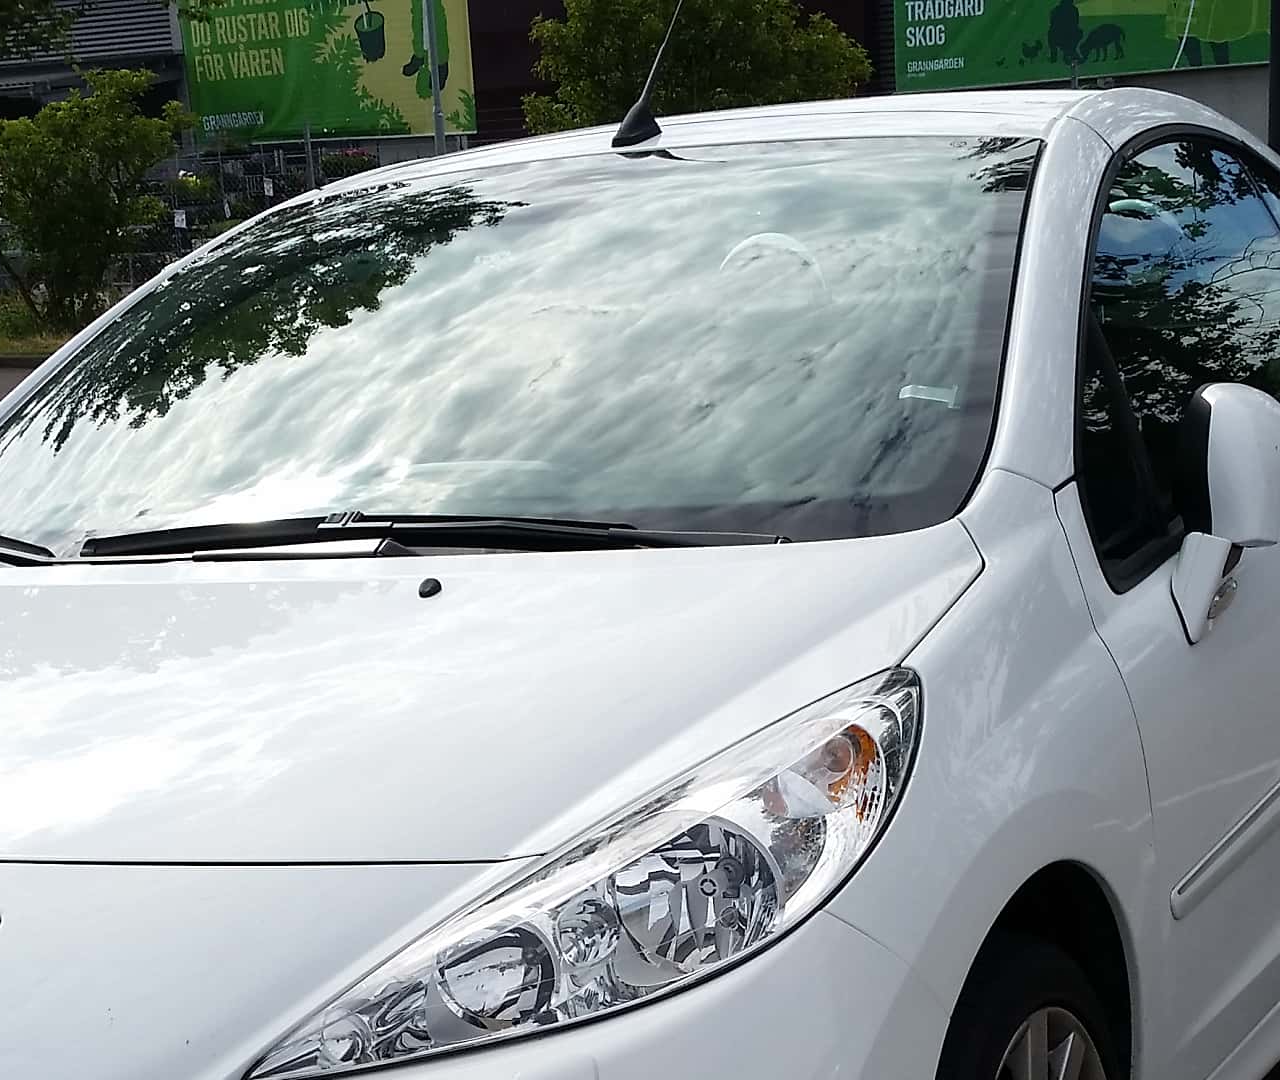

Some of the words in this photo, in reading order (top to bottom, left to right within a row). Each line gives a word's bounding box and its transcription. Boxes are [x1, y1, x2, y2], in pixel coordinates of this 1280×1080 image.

[191, 21, 211, 47] DU
[215, 11, 280, 44] RUSTAR
[284, 8, 310, 38] DIG
[905, 24, 946, 48] SKOG
[194, 48, 226, 82] FÖR
[228, 44, 284, 79] VÅREN
